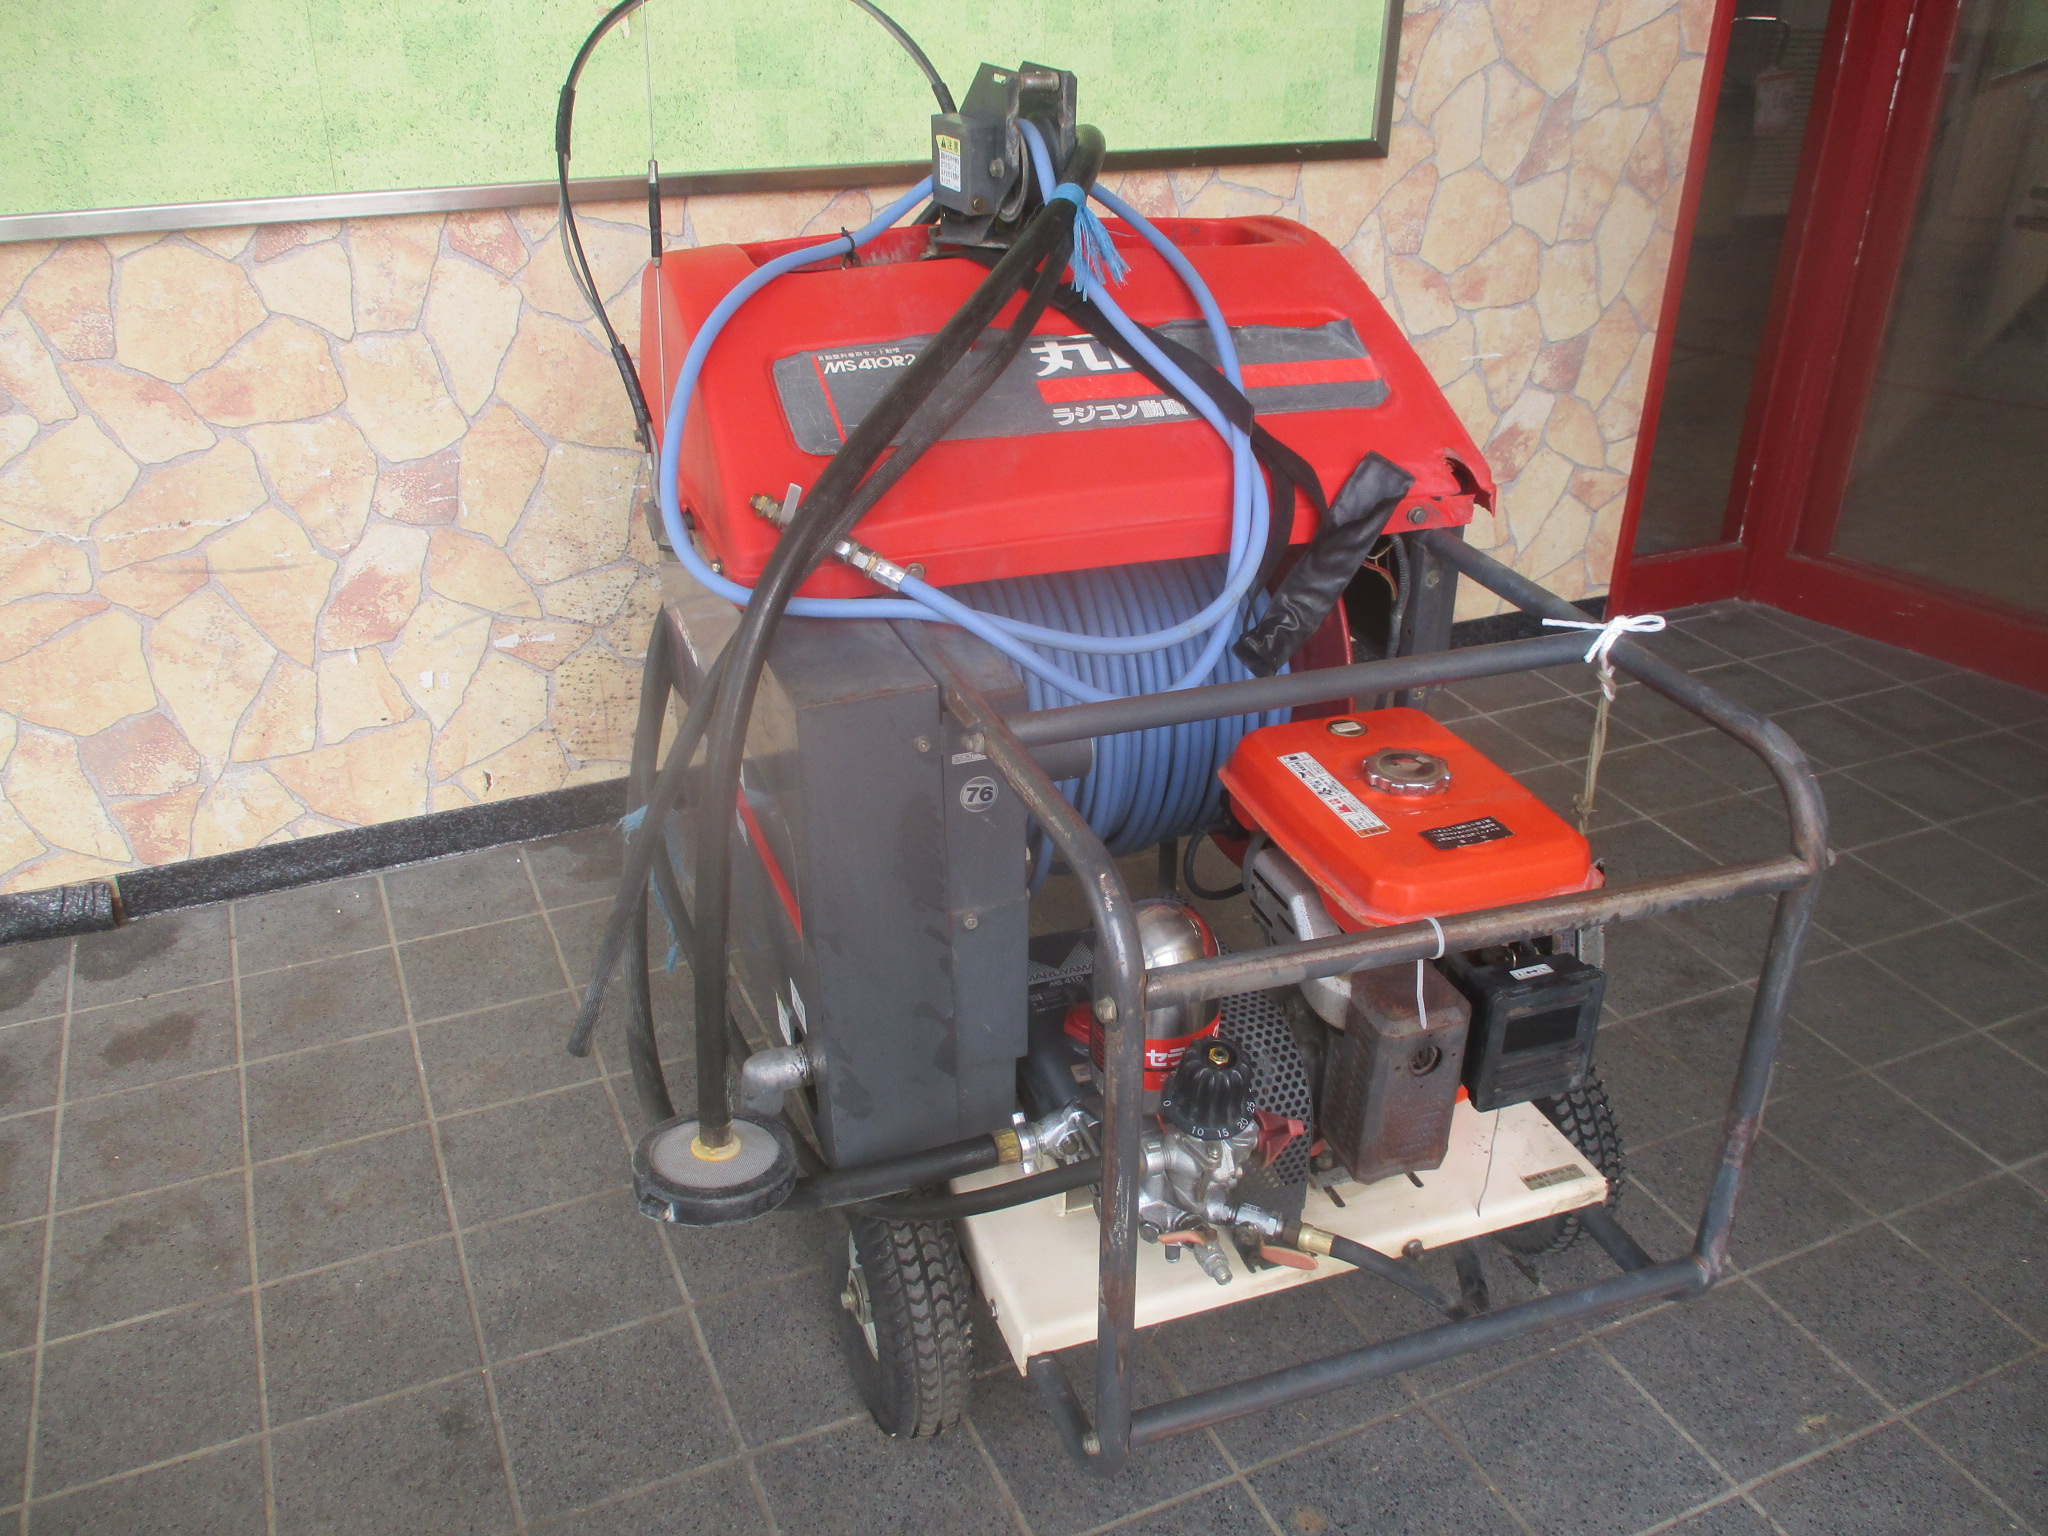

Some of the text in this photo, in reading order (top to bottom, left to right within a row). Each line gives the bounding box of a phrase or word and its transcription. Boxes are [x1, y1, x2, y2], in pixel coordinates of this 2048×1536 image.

[1030, 341, 1132, 377] 丸
[966, 785, 994, 803] 76
[1065, 975, 1084, 984] 410
[1191, 1125, 1205, 1137] 10
[1217, 1128, 1230, 1138] 15
[1236, 1117, 1249, 1130] 20
[1246, 1101, 1256, 1114] 25
